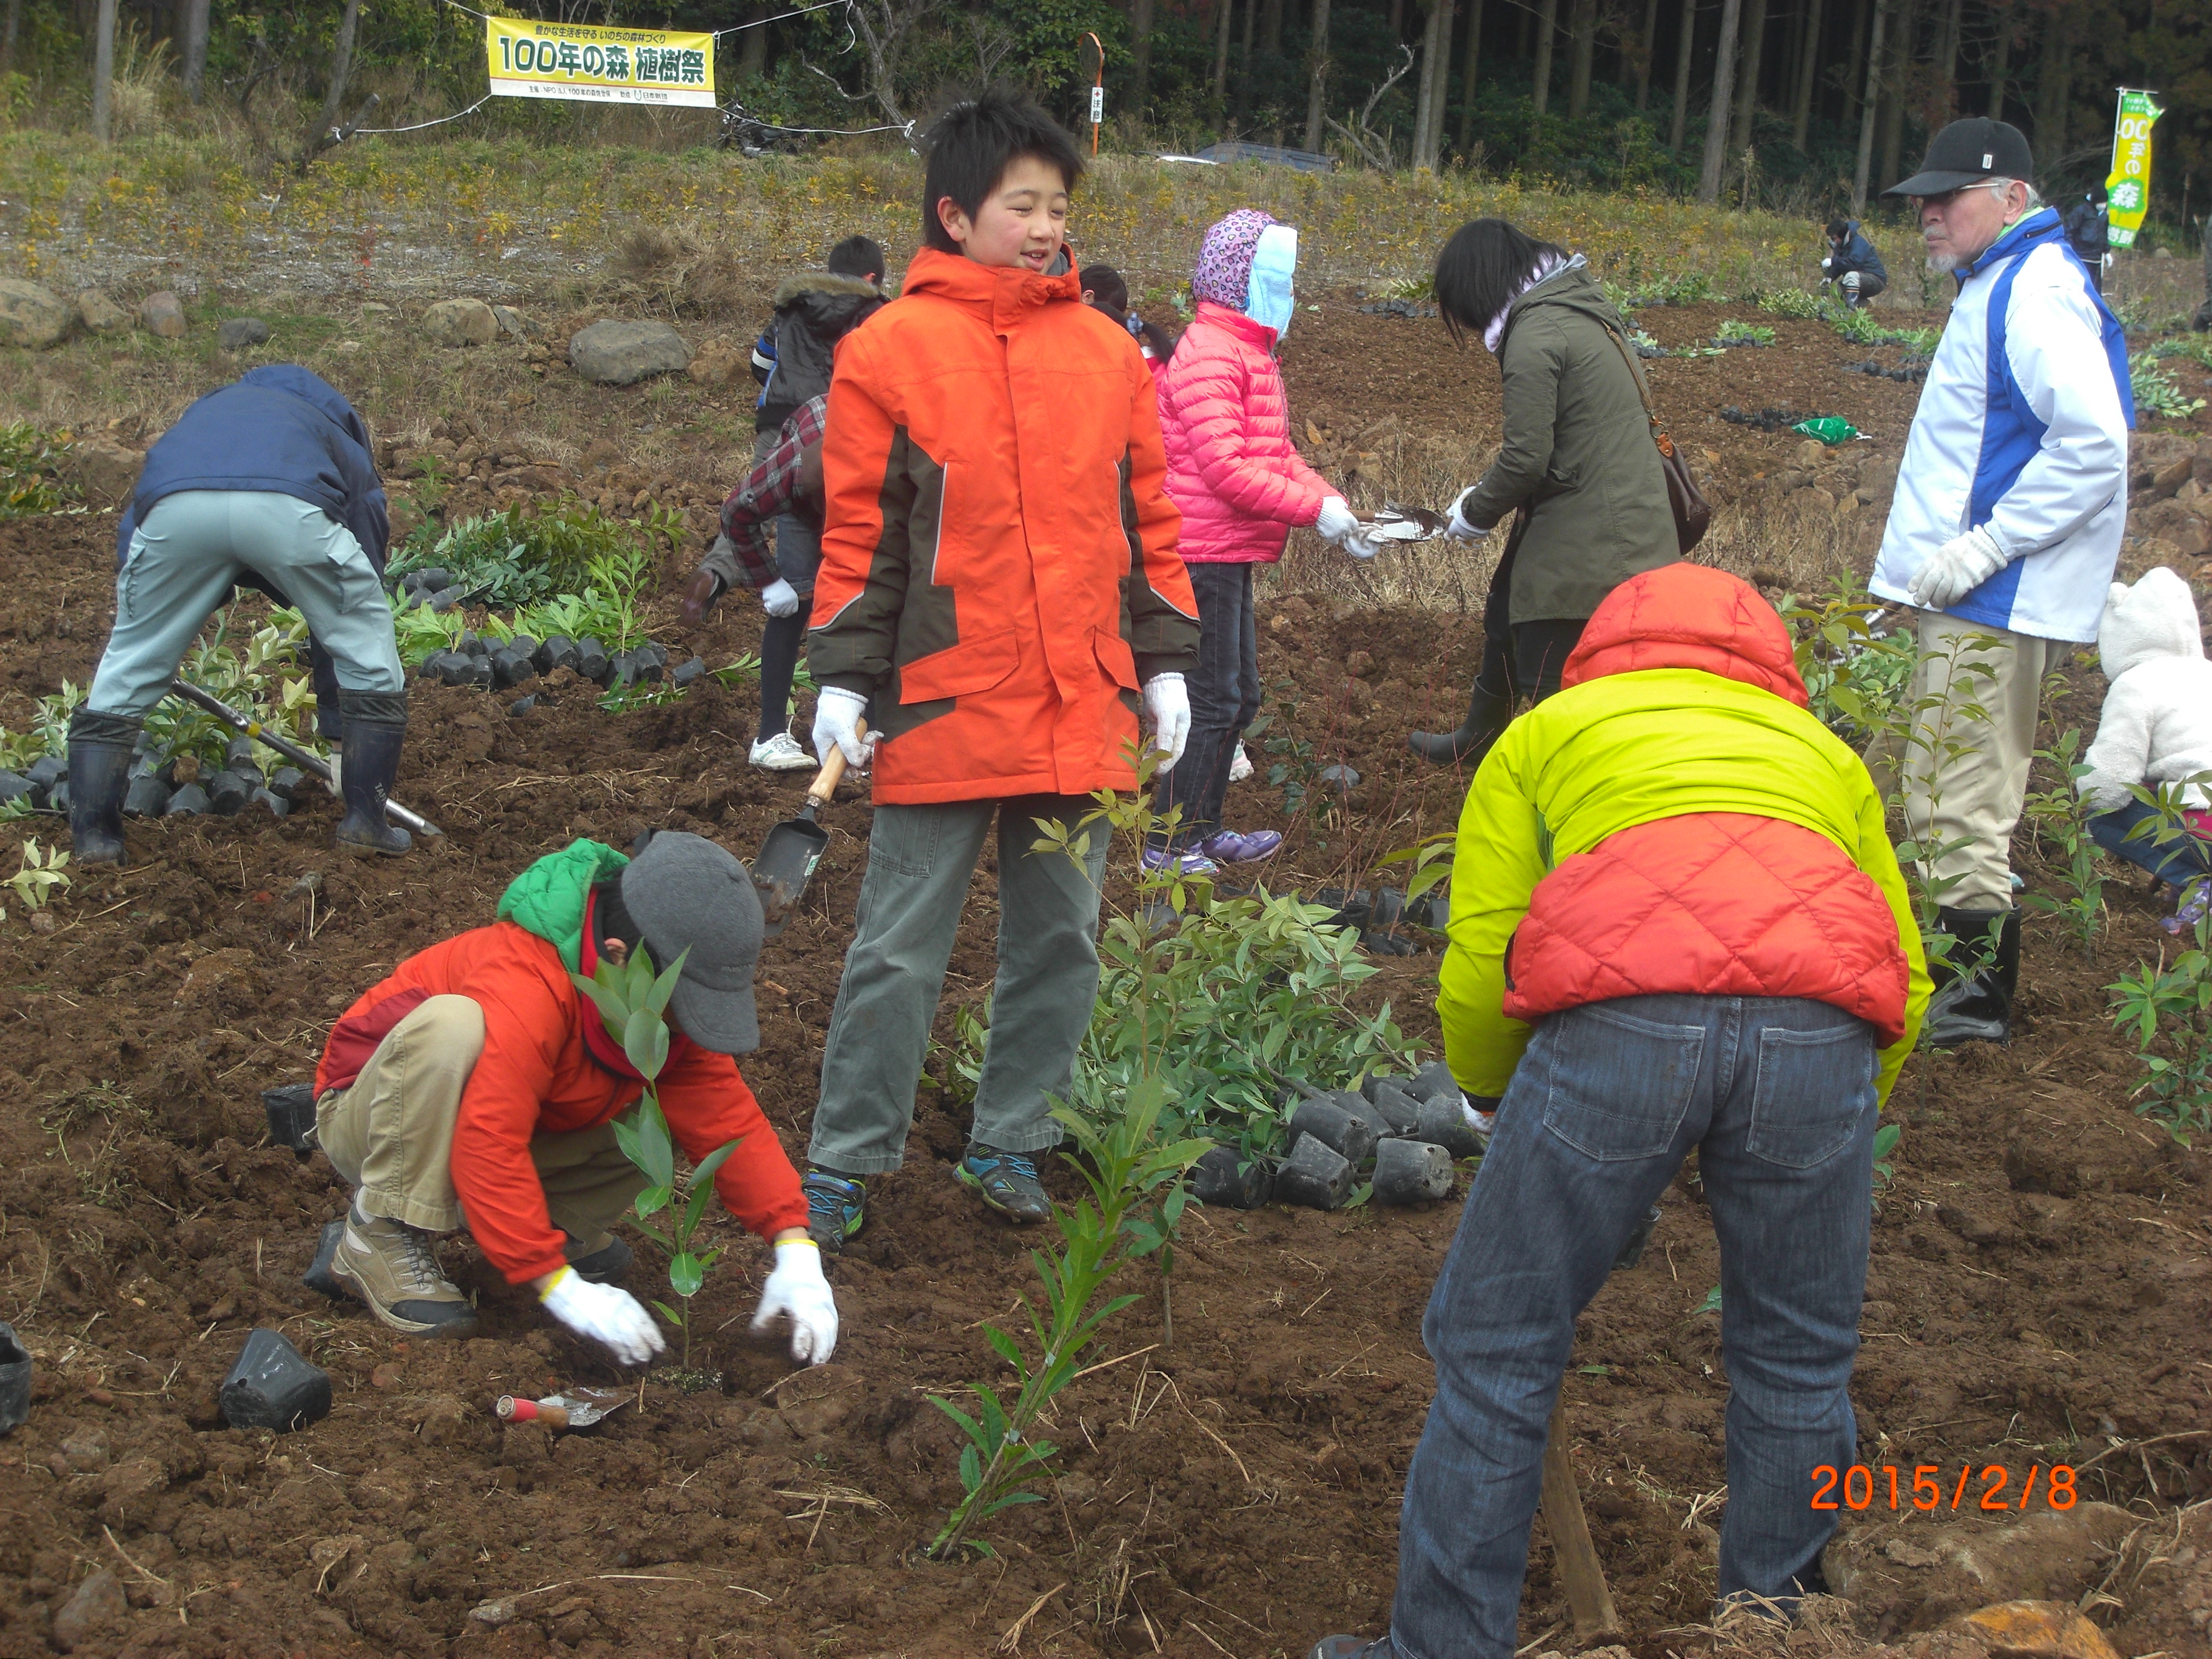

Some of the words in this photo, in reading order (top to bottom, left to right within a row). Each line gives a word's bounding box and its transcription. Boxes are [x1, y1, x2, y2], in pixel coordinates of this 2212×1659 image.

[535, 25, 597, 39] 豊かな生活を守る
[600, 30, 666, 44] いのちの森林づくり
[498, 36, 630, 81] 100年の森
[635, 46, 706, 85] 植樹祭
[1093, 99, 1101, 119] 注意
